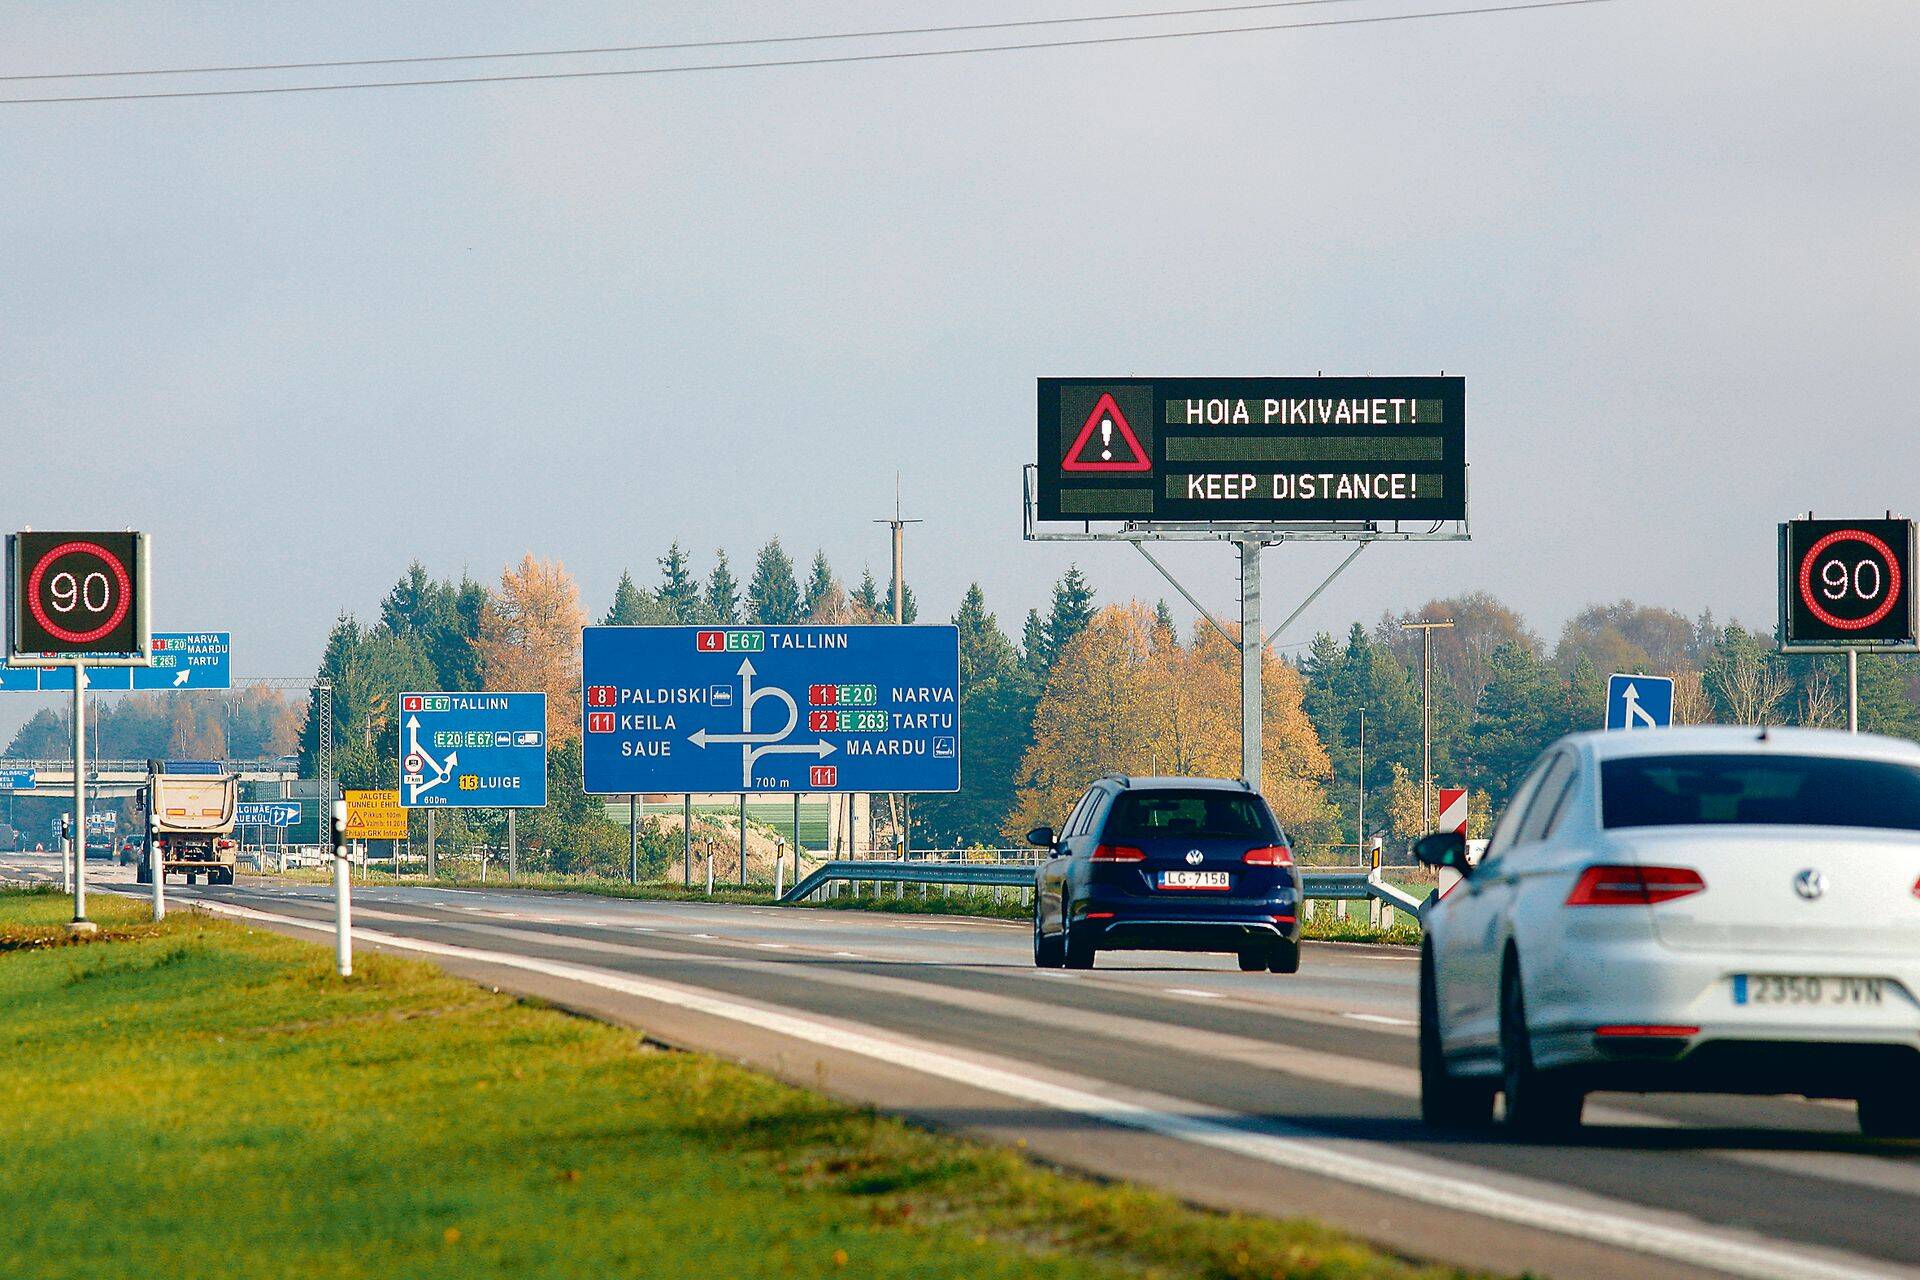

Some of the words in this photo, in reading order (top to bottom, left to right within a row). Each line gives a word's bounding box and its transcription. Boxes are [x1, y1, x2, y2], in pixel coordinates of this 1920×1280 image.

[1187, 398, 1250, 424] HOIA
[1264, 398, 1417, 424] PIKIVAHET!
[1188, 474, 1256, 499] KEEP
[1273, 474, 1417, 499] DISTANCE!
[1822, 560, 1880, 600] 90
[50, 572, 110, 612] 90
[187, 634, 220, 644] NARVA
[706, 634, 716, 649] 4
[770, 634, 848, 649] TALLINN
[187, 644, 228, 654] MAARDU
[188, 656, 219, 666] TARTU
[598, 689, 607, 704] 8
[621, 688, 707, 704] PALDISKI
[820, 688, 828, 702] 1
[892, 688, 954, 702] NARVA
[409, 699, 417, 710] 4
[452, 698, 508, 710] TALLINN
[592, 716, 611, 730] 11
[621, 715, 677, 730] KEILA
[819, 714, 828, 729] 2
[893, 714, 952, 729] TARTU
[621, 741, 671, 756] SAUE
[846, 740, 926, 755] MAARDU
[461, 778, 476, 787] 15
[480, 777, 520, 788] LUIGE
[756, 778, 776, 788] 700
[780, 779, 789, 787] m
[814, 768, 832, 784] 11
[1754, 976, 1821, 1004] 2350
